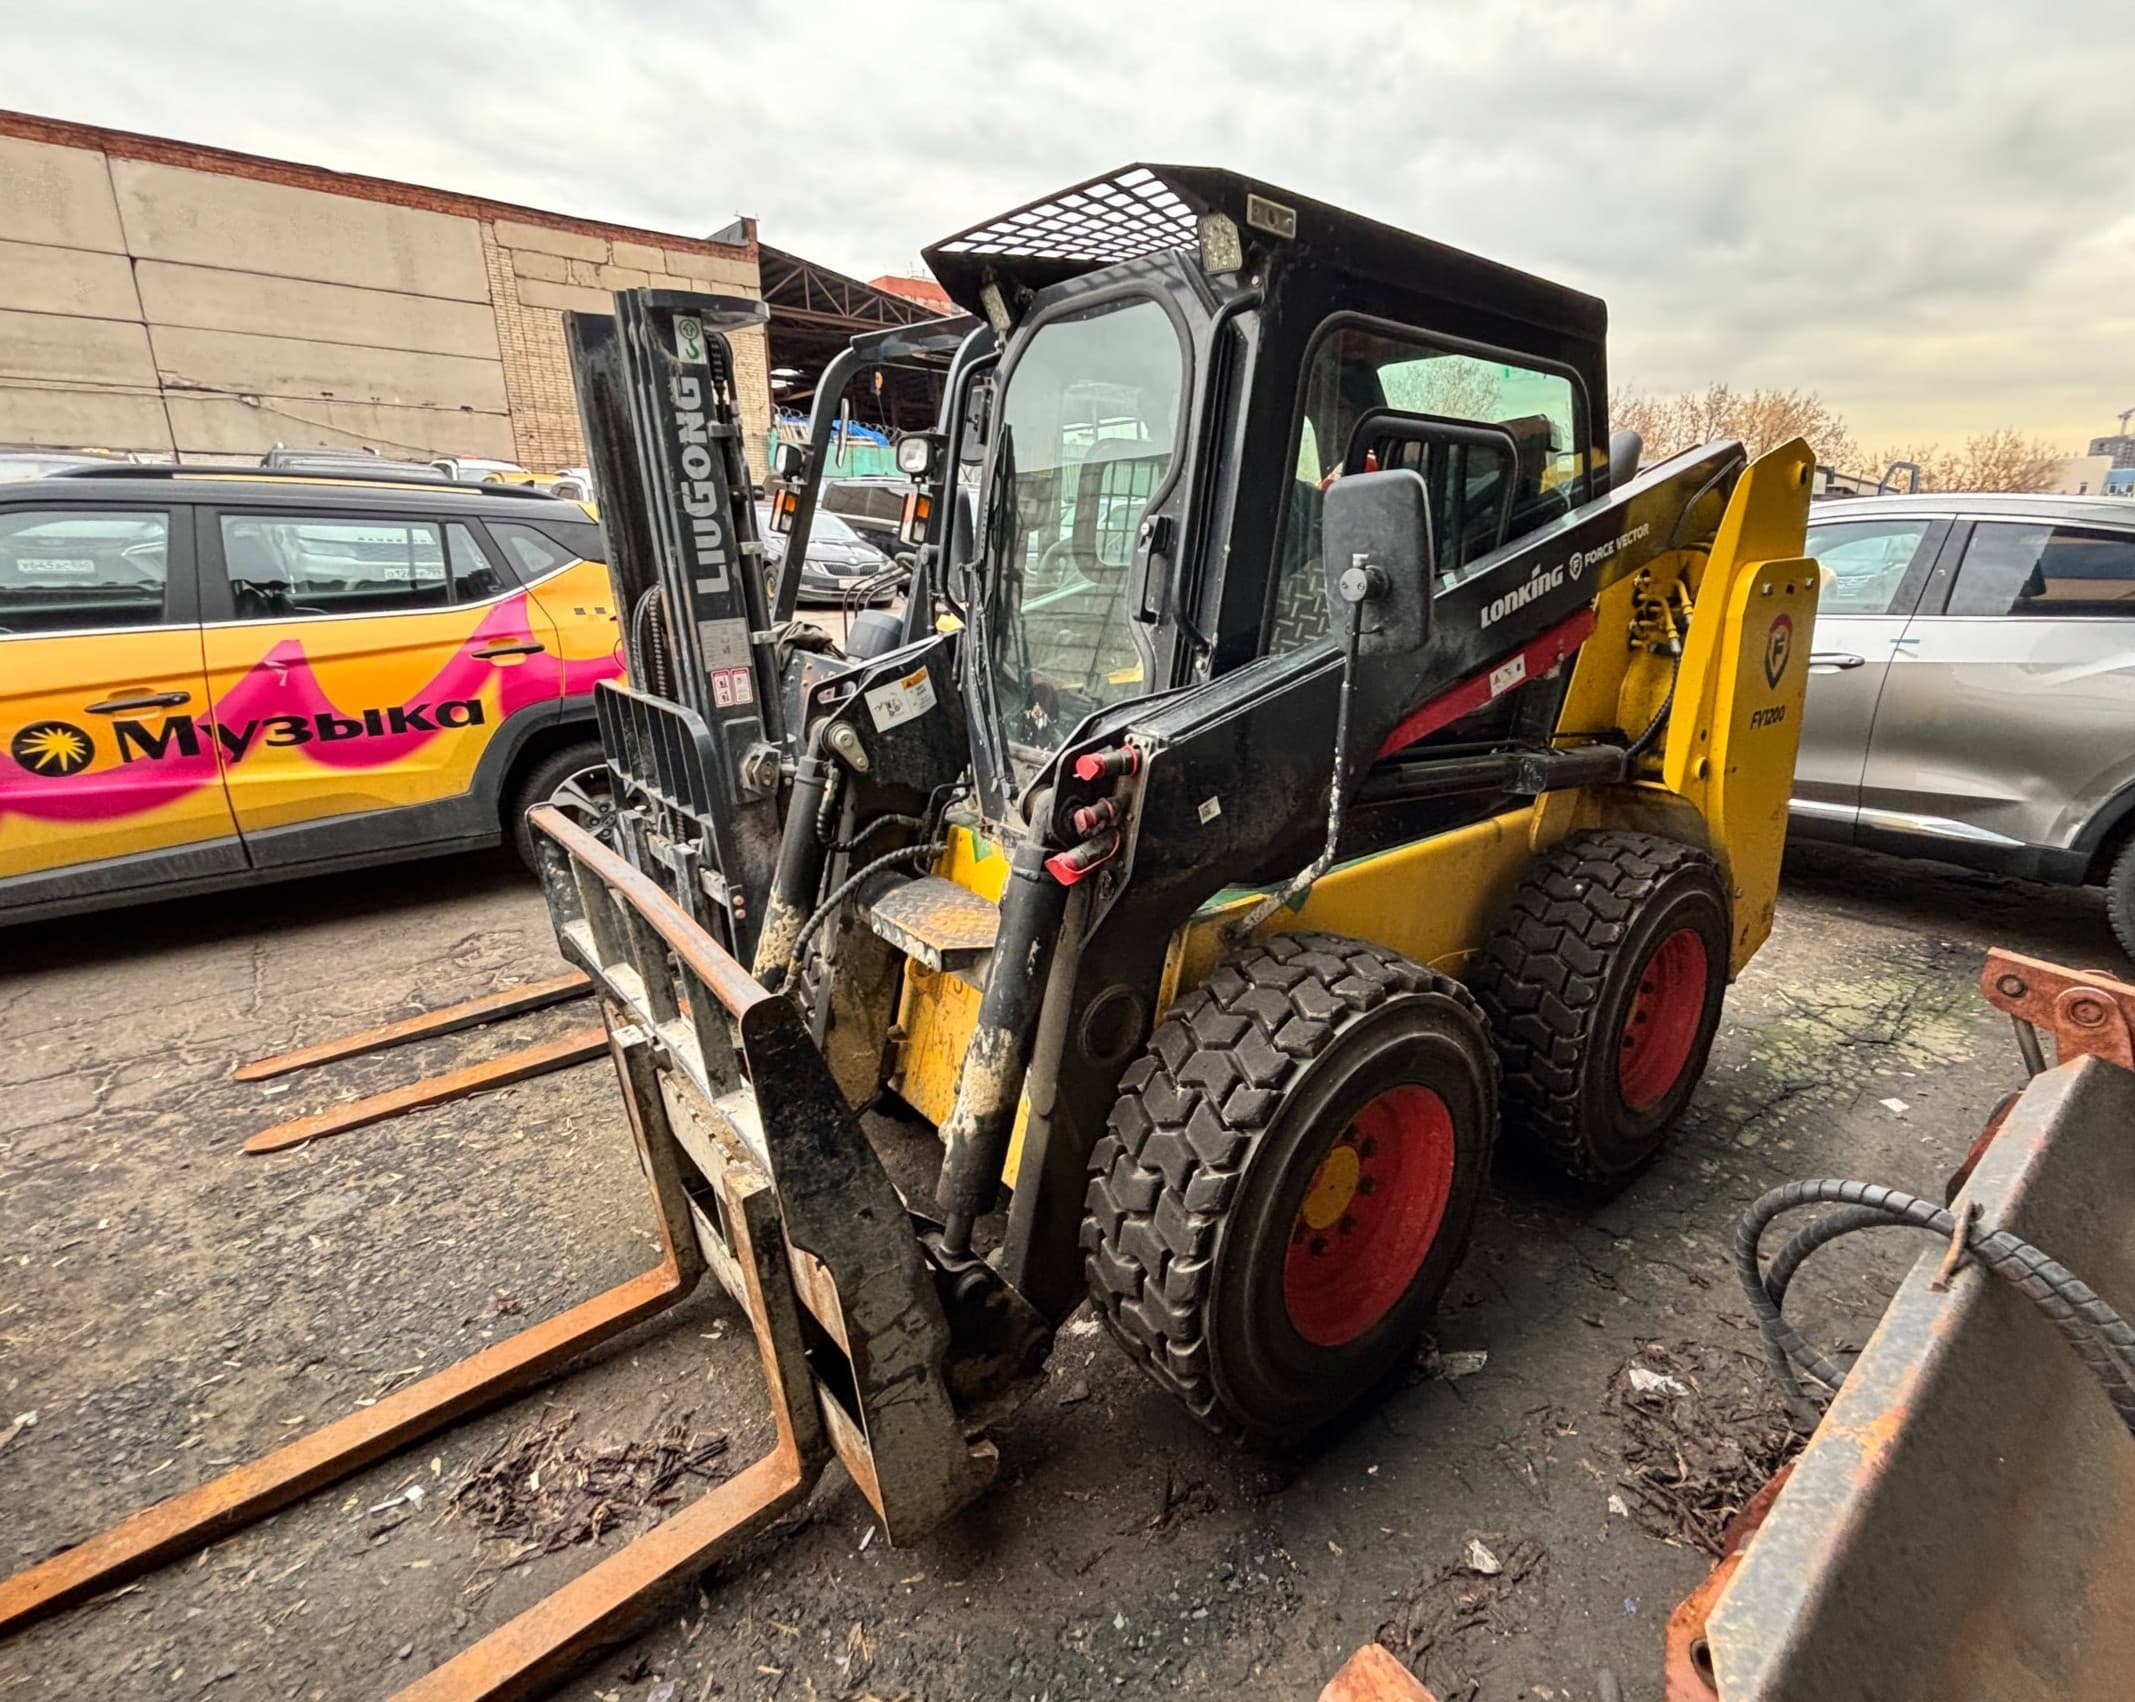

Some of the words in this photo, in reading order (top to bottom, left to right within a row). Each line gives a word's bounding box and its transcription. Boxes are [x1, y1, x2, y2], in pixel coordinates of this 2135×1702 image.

[675, 377, 730, 594] LIUGONG
[1584, 540, 1615, 567] FORCE
[1616, 523, 1650, 550] VECTOR
[112, 699, 485, 763] Музыка
[1750, 704, 1786, 731] FV1200
